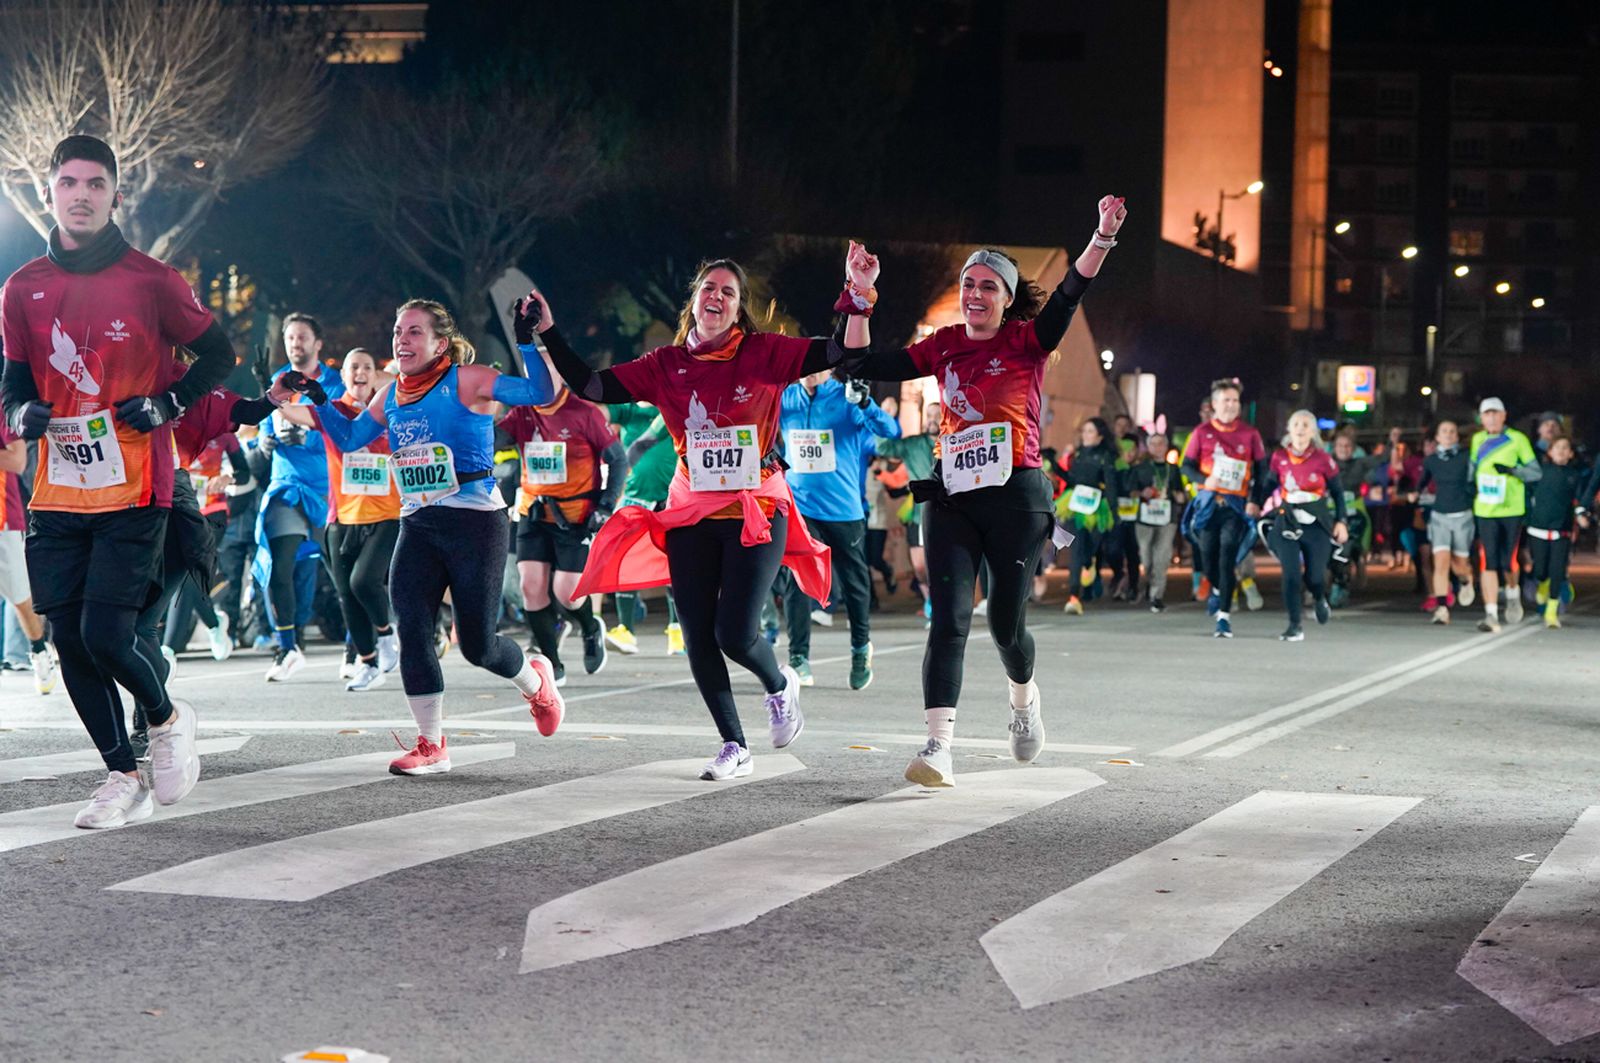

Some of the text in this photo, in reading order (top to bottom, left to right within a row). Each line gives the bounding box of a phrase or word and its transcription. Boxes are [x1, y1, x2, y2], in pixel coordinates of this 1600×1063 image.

[68, 361, 84, 383] 43
[951, 395, 967, 414] 43
[71, 425, 81, 433] DE
[976, 431, 984, 439] DE
[694, 441, 708, 449] SAN
[800, 445, 822, 458] 590
[950, 444, 963, 454] SAN
[55, 440, 105, 465] 6691
[702, 448, 743, 468] 6147
[954, 444, 999, 471] 4664
[532, 457, 557, 470] 9091
[352, 467, 381, 481] 8156
[400, 464, 448, 487] 13002
